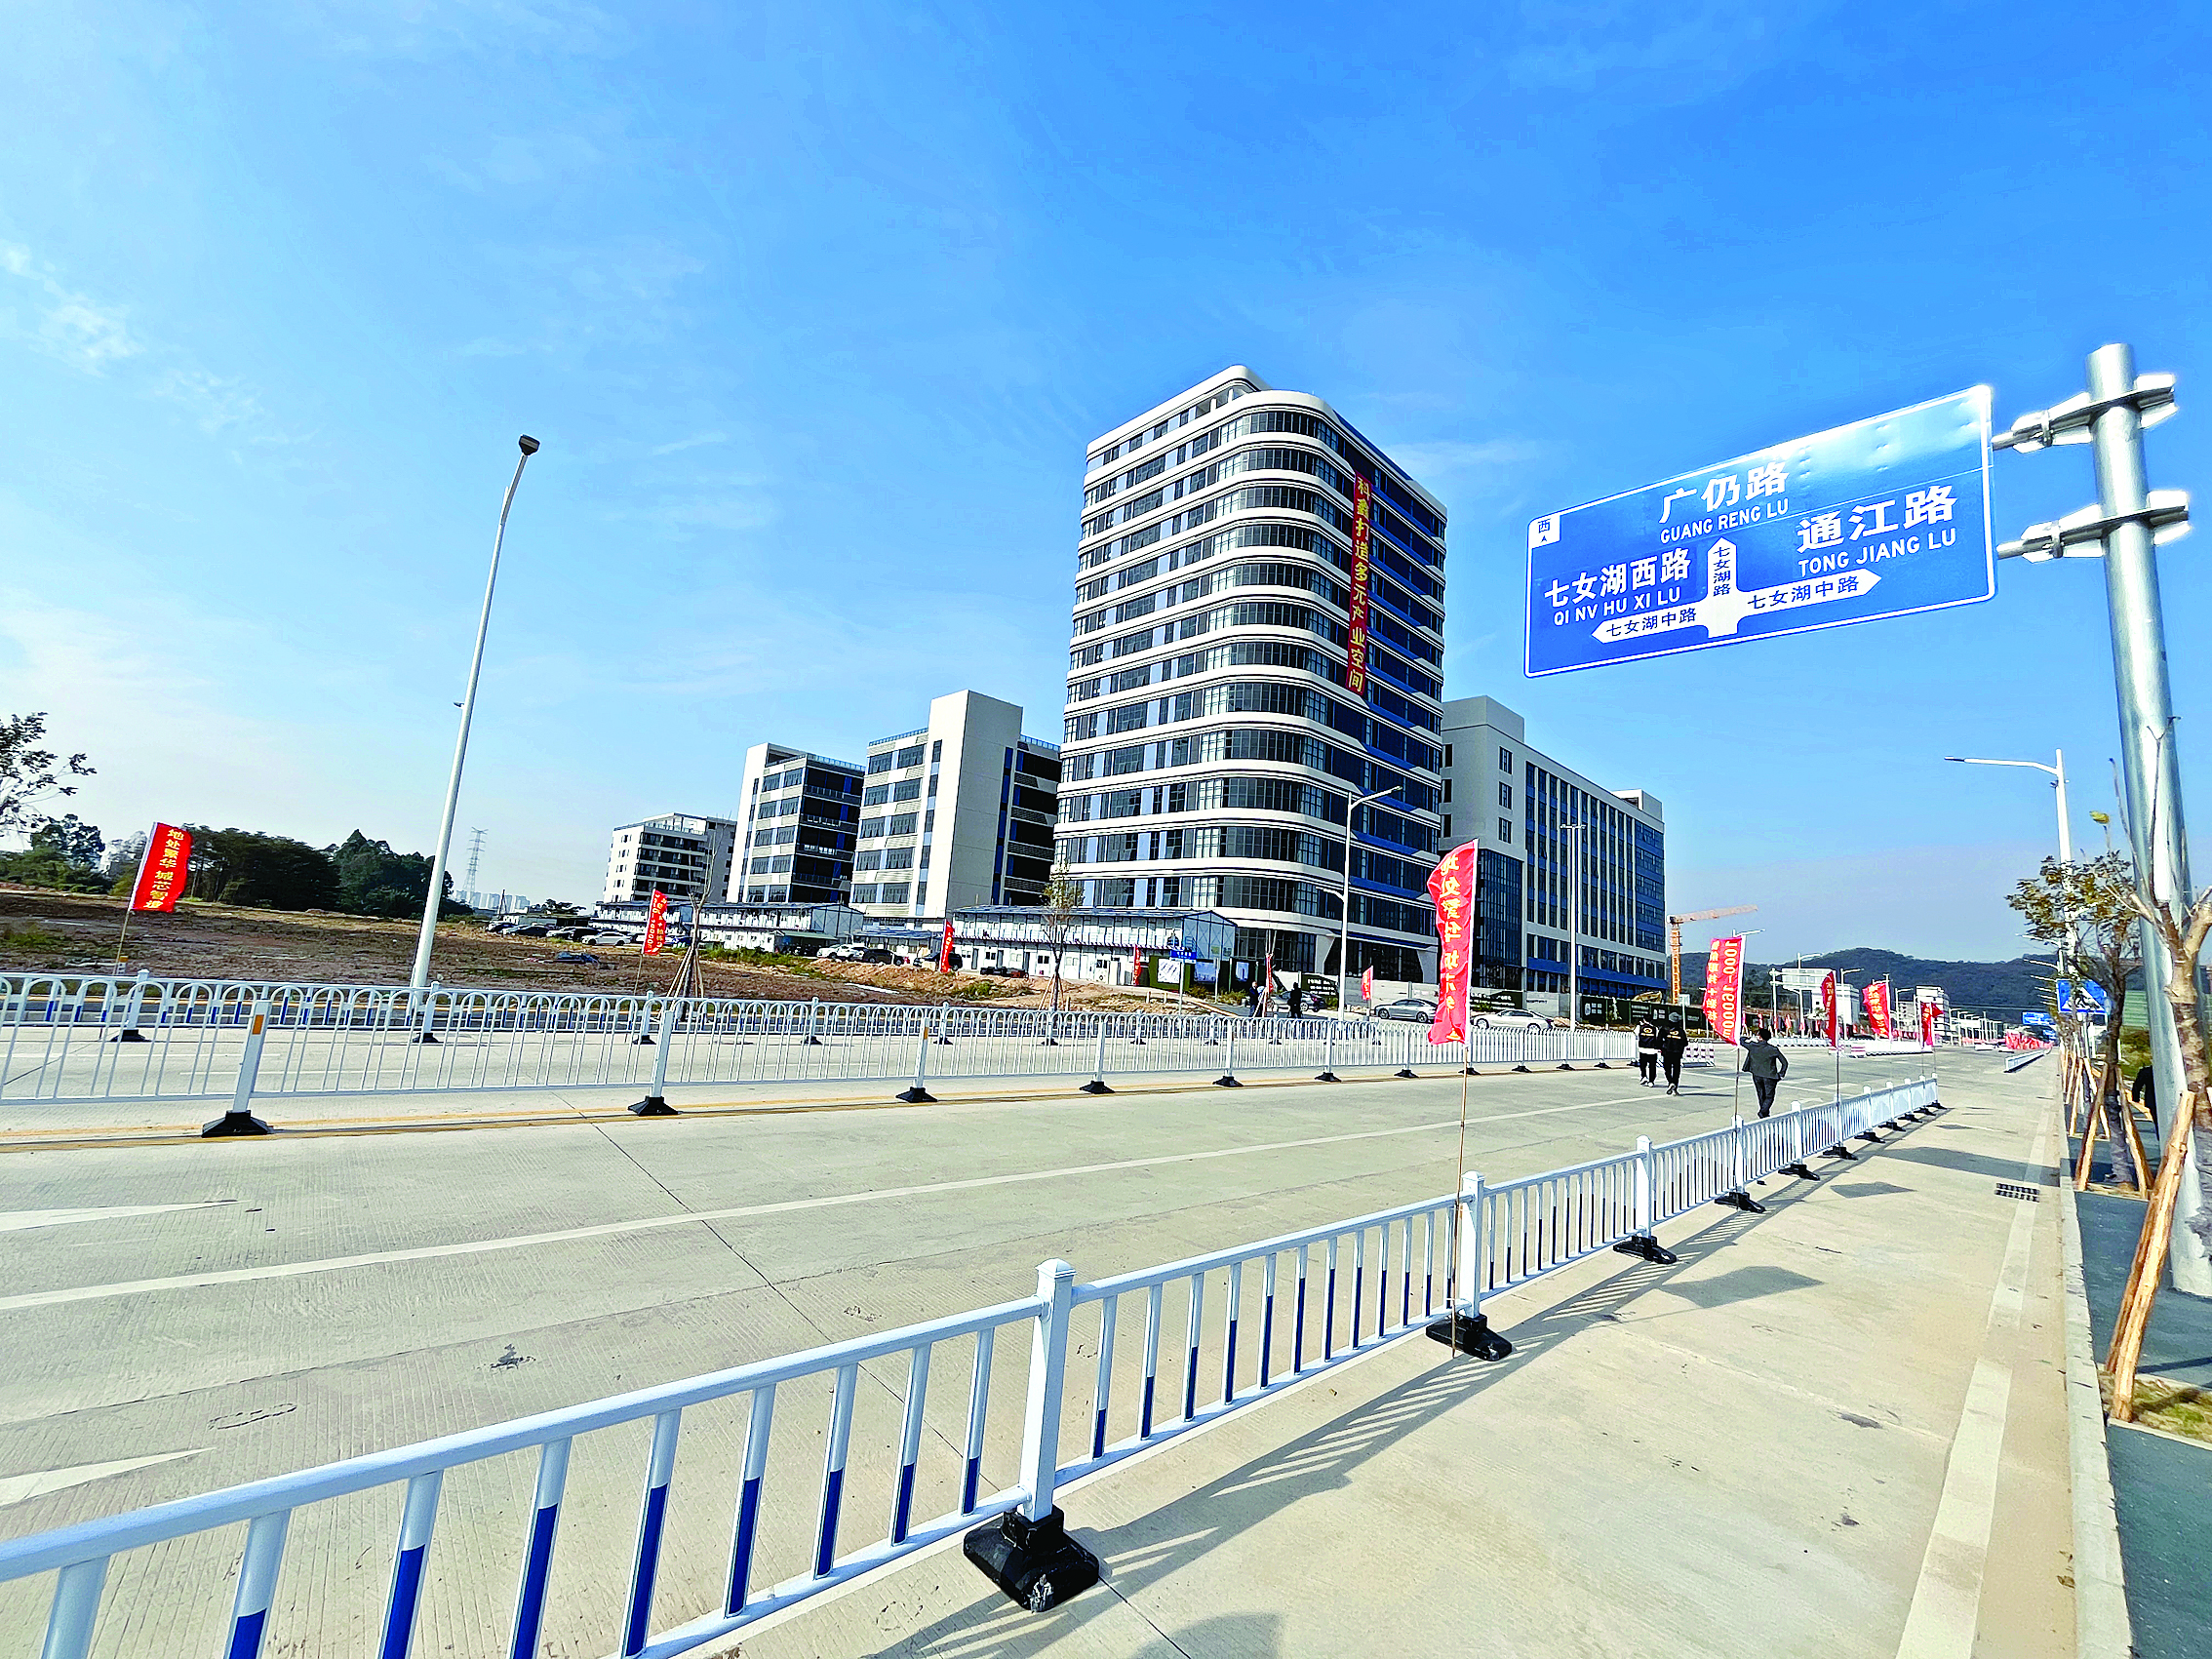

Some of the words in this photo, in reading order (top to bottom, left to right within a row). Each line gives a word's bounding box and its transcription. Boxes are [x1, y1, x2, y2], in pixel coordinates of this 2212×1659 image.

[1658, 462, 1790, 524] 广仍路
[1537, 518, 1552, 533] 西
[1660, 518, 1714, 544] GUANG
[1718, 505, 1761, 531] RENG
[1766, 497, 1789, 519] LU
[1797, 485, 1958, 554] 通江路
[1713, 546, 1731, 597] 七女湖路
[1797, 551, 1850, 577] TONG
[1855, 535, 1920, 565] JIANG
[1928, 527, 1956, 550] LU
[1544, 547, 1691, 608] 七女湖西路
[1748, 575, 1859, 610] 七女湖中路
[1554, 610, 1569, 626] QI
[1575, 604, 1599, 622] NV
[1603, 597, 1627, 616] HU
[1633, 592, 1651, 611] XI
[1657, 586, 1680, 606] LU
[1606, 607, 1697, 637] 七女湖中路
